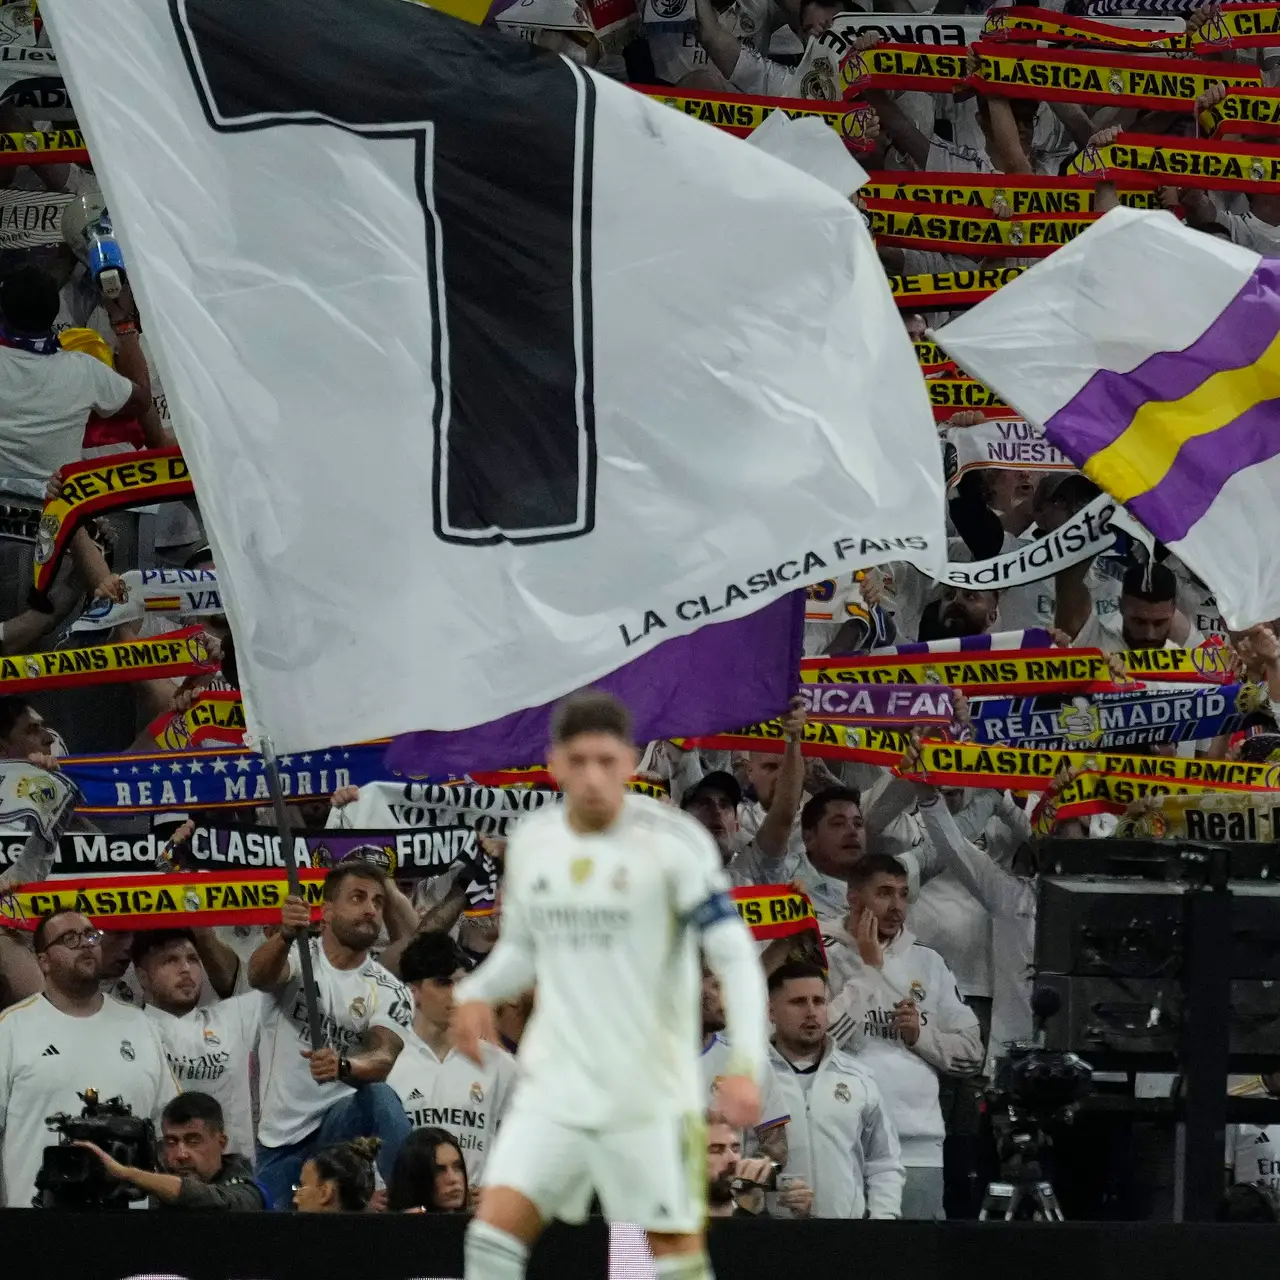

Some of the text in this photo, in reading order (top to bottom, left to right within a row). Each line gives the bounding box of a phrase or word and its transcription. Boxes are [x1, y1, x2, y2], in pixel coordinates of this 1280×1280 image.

[1128, 73, 1193, 100] FANS
[60, 460, 158, 506] REYES
[617, 533, 929, 648] LA CLASICA FANS
[113, 642, 183, 670] RMCF
[984, 692, 1227, 740] REAL MADRID
[115, 767, 352, 807] REAL MADRID
[402, 782, 498, 808] COMO
[1184, 807, 1258, 842] Real
[205, 883, 279, 910] FANS
[405, 1106, 486, 1130] SIEMENS
